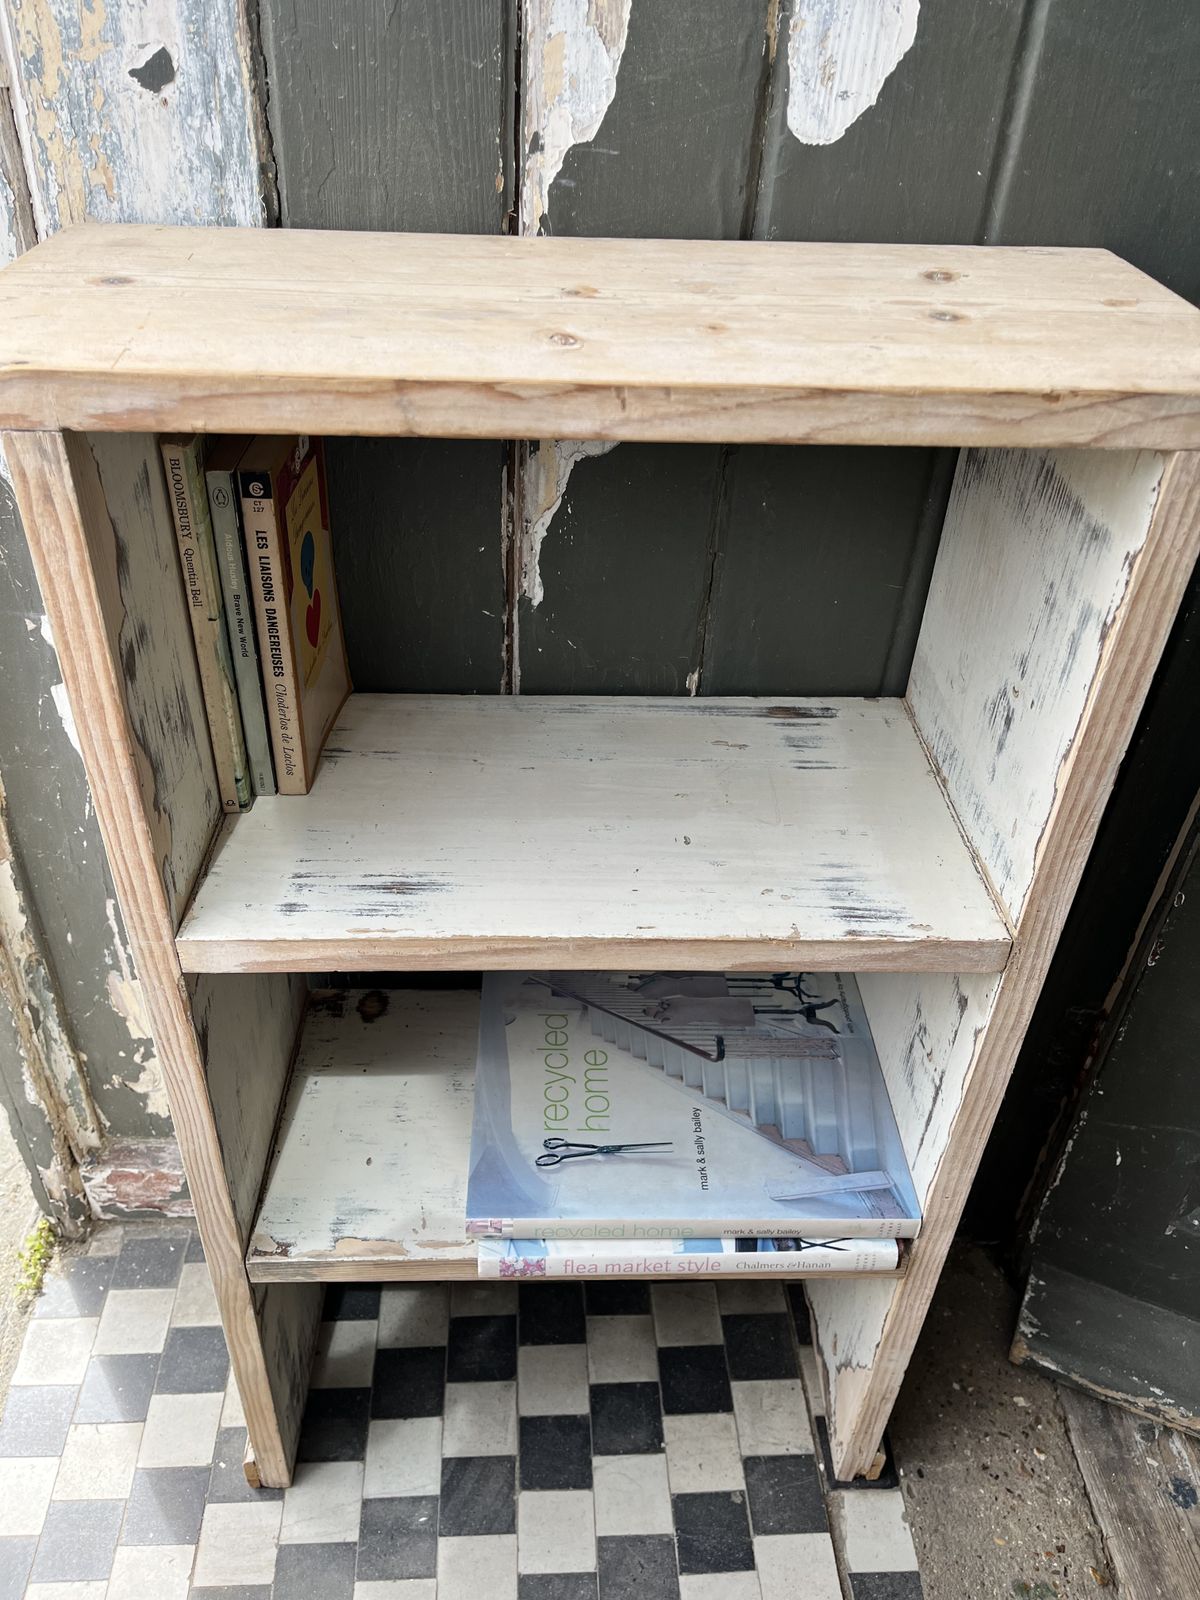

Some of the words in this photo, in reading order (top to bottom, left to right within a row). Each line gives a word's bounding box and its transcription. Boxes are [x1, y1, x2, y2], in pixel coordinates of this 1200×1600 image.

[169, 458, 193, 540] BLOOMSBURY
[183, 548, 197, 587] Quentin
[190, 589, 203, 608] Bell
[255, 530, 268, 550] LES
[223, 533, 234, 562] Aldous
[259, 556, 275, 602] LIAISONS
[233, 594, 242, 616] Brave
[236, 618, 245, 634] New
[240, 636, 250, 658] World
[265, 608, 285, 677] DANGEREUSES
[274, 683, 289, 731] Choderlos
[281, 733, 289, 744] de
[282, 746, 297, 776] Laclos
[536, 1014, 577, 1131] recycled
[576, 1049, 610, 1131] home
[690, 1107, 703, 1133] bailey
[693, 1134, 707, 1156] sally
[696, 1157, 706, 1165] &
[697, 1166, 709, 1191] mark
[534, 1224, 625, 1240] recycled
[632, 1224, 695, 1238] home
[563, 1259, 599, 1274] flea
[604, 1258, 672, 1273] market
[676, 1256, 721, 1274] style
[735, 1261, 785, 1270] Chalmers
